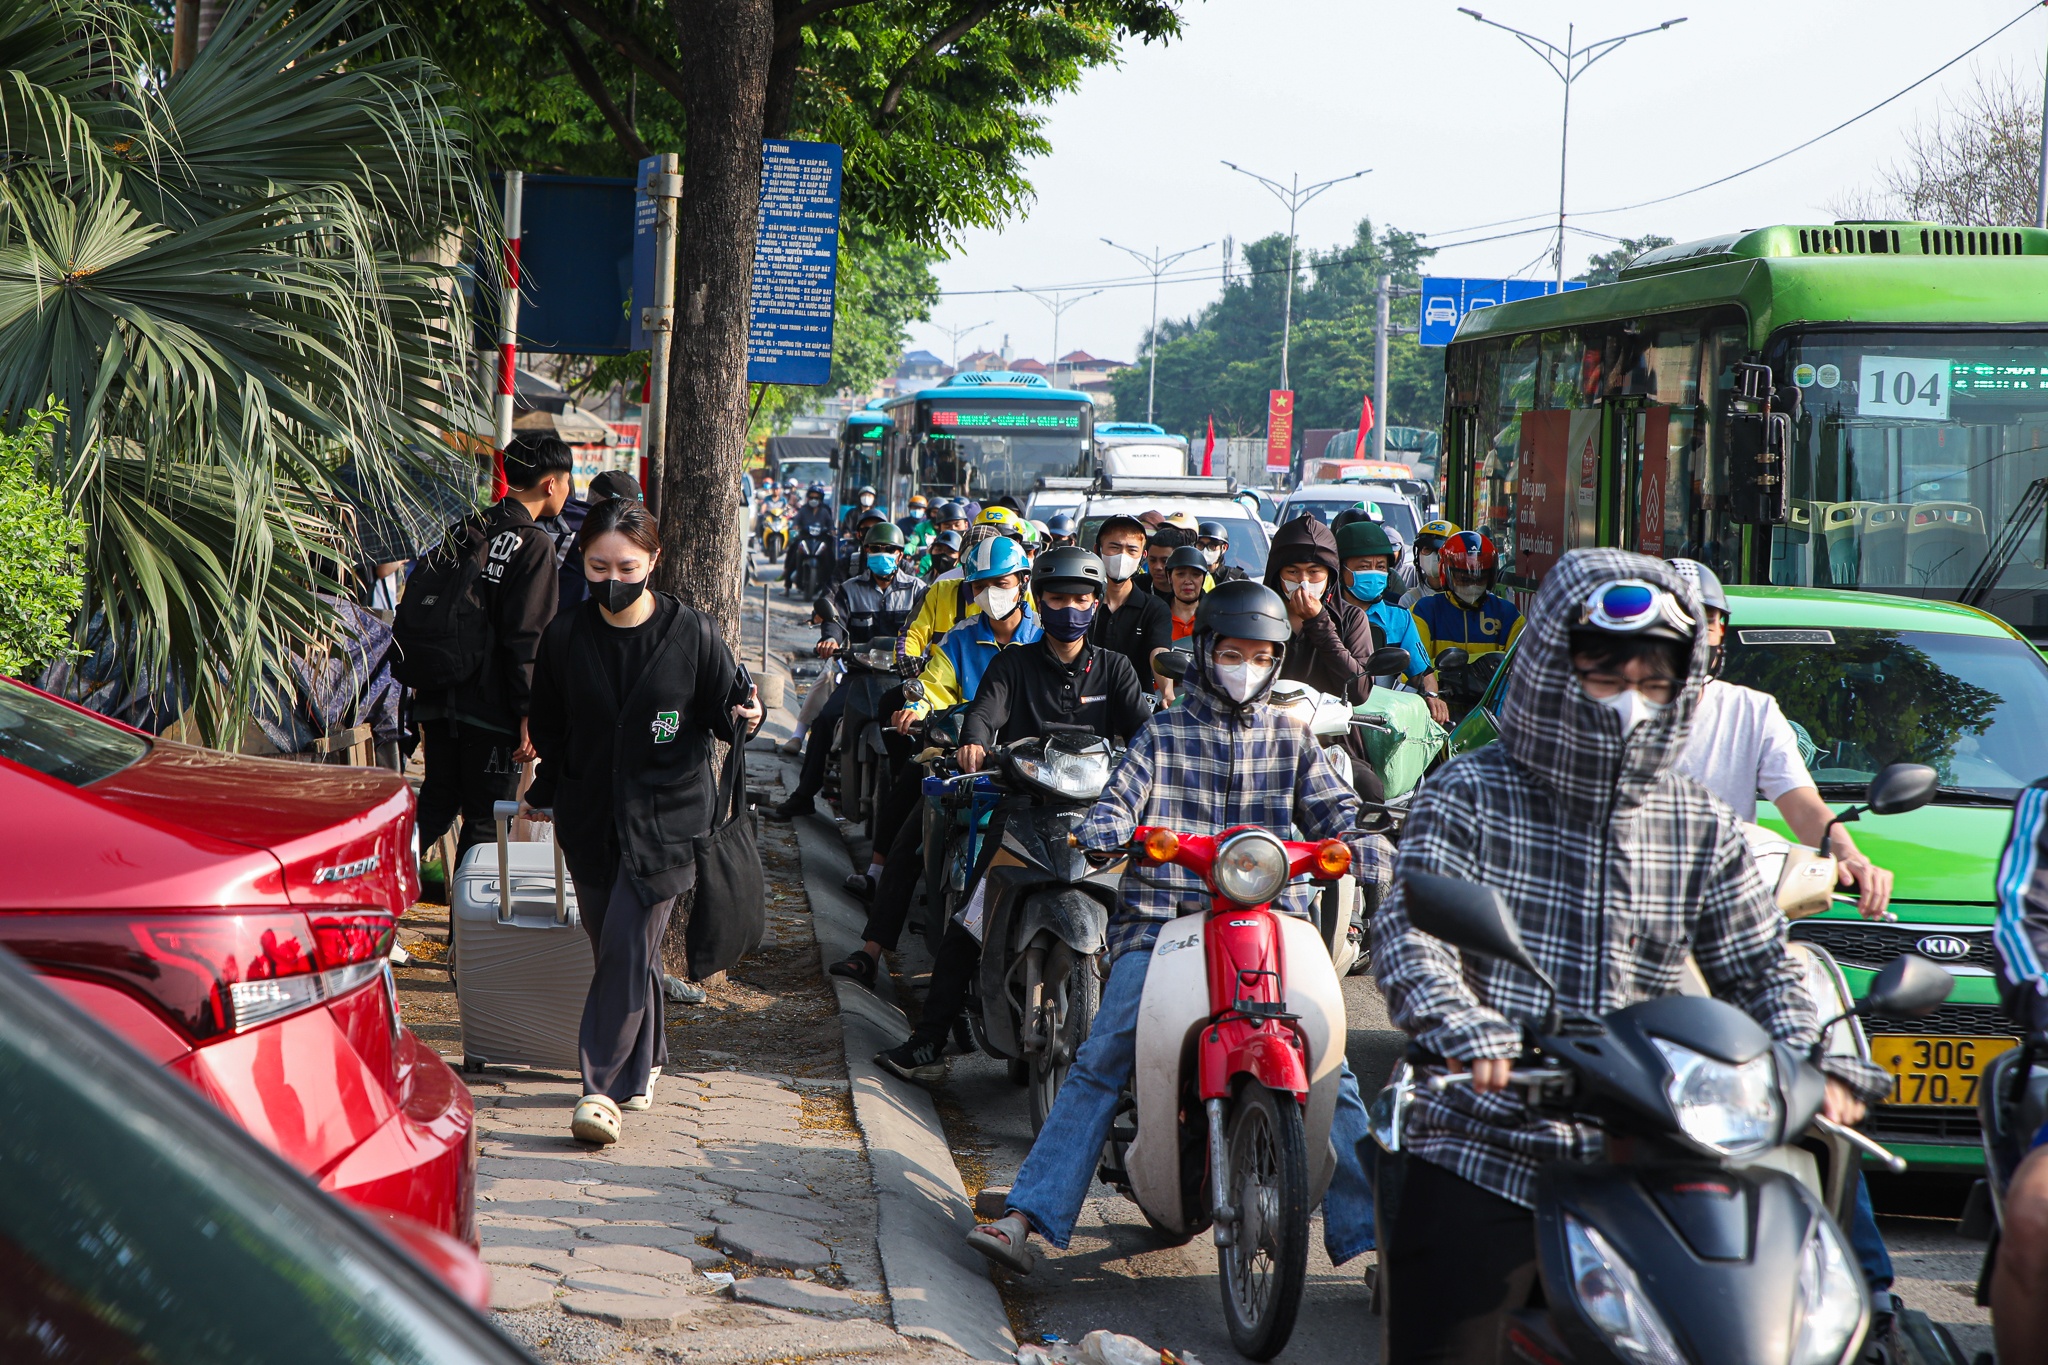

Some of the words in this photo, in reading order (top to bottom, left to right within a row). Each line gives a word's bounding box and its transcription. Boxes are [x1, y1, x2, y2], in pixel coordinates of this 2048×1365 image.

[1869, 370, 1940, 406] 104
[986, 511, 1003, 520] be
[1428, 523, 1446, 532] be
[1480, 611, 1502, 635] be
[1157, 934, 1199, 956] Cub
[1924, 939, 1960, 954] KIA
[1913, 1040, 1975, 1069] 30G
[1894, 1072, 1980, 1104] 170.7
